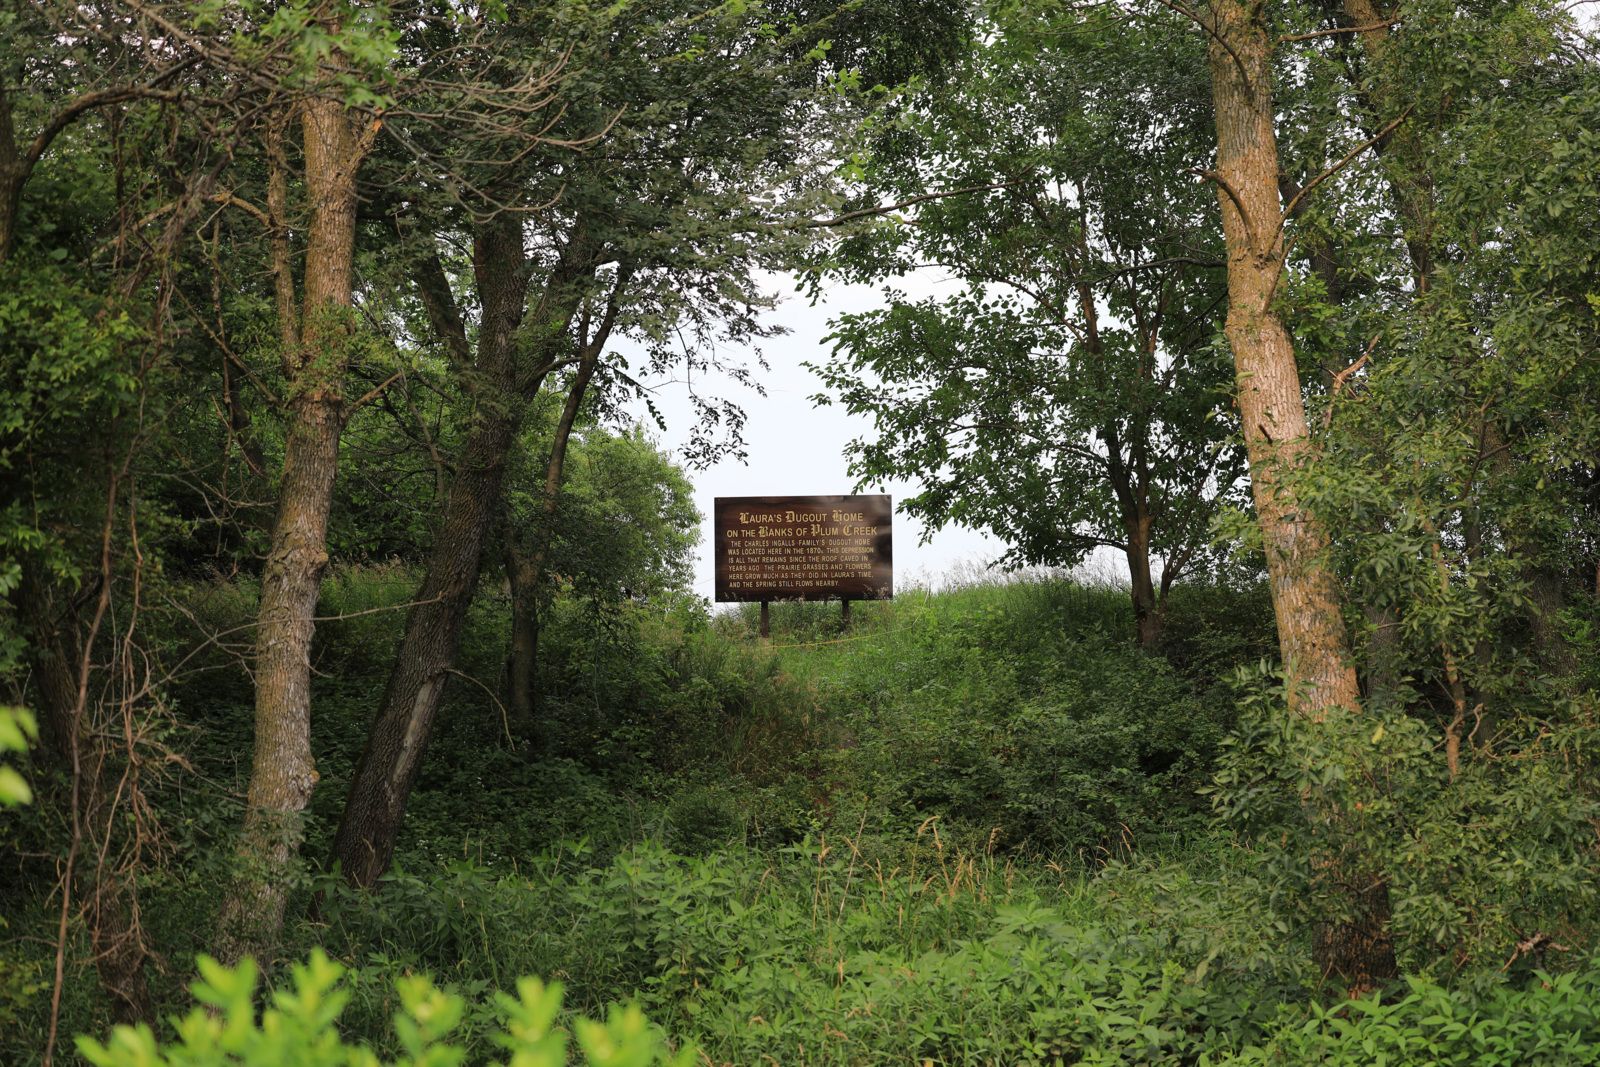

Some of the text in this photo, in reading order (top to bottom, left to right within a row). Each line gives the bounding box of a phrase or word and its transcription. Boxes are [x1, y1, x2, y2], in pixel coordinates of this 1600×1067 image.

[759, 526, 792, 537] BANKS
[796, 528, 807, 536] OF
[811, 524, 838, 536] PLUM
[843, 525, 877, 536] CREEK
